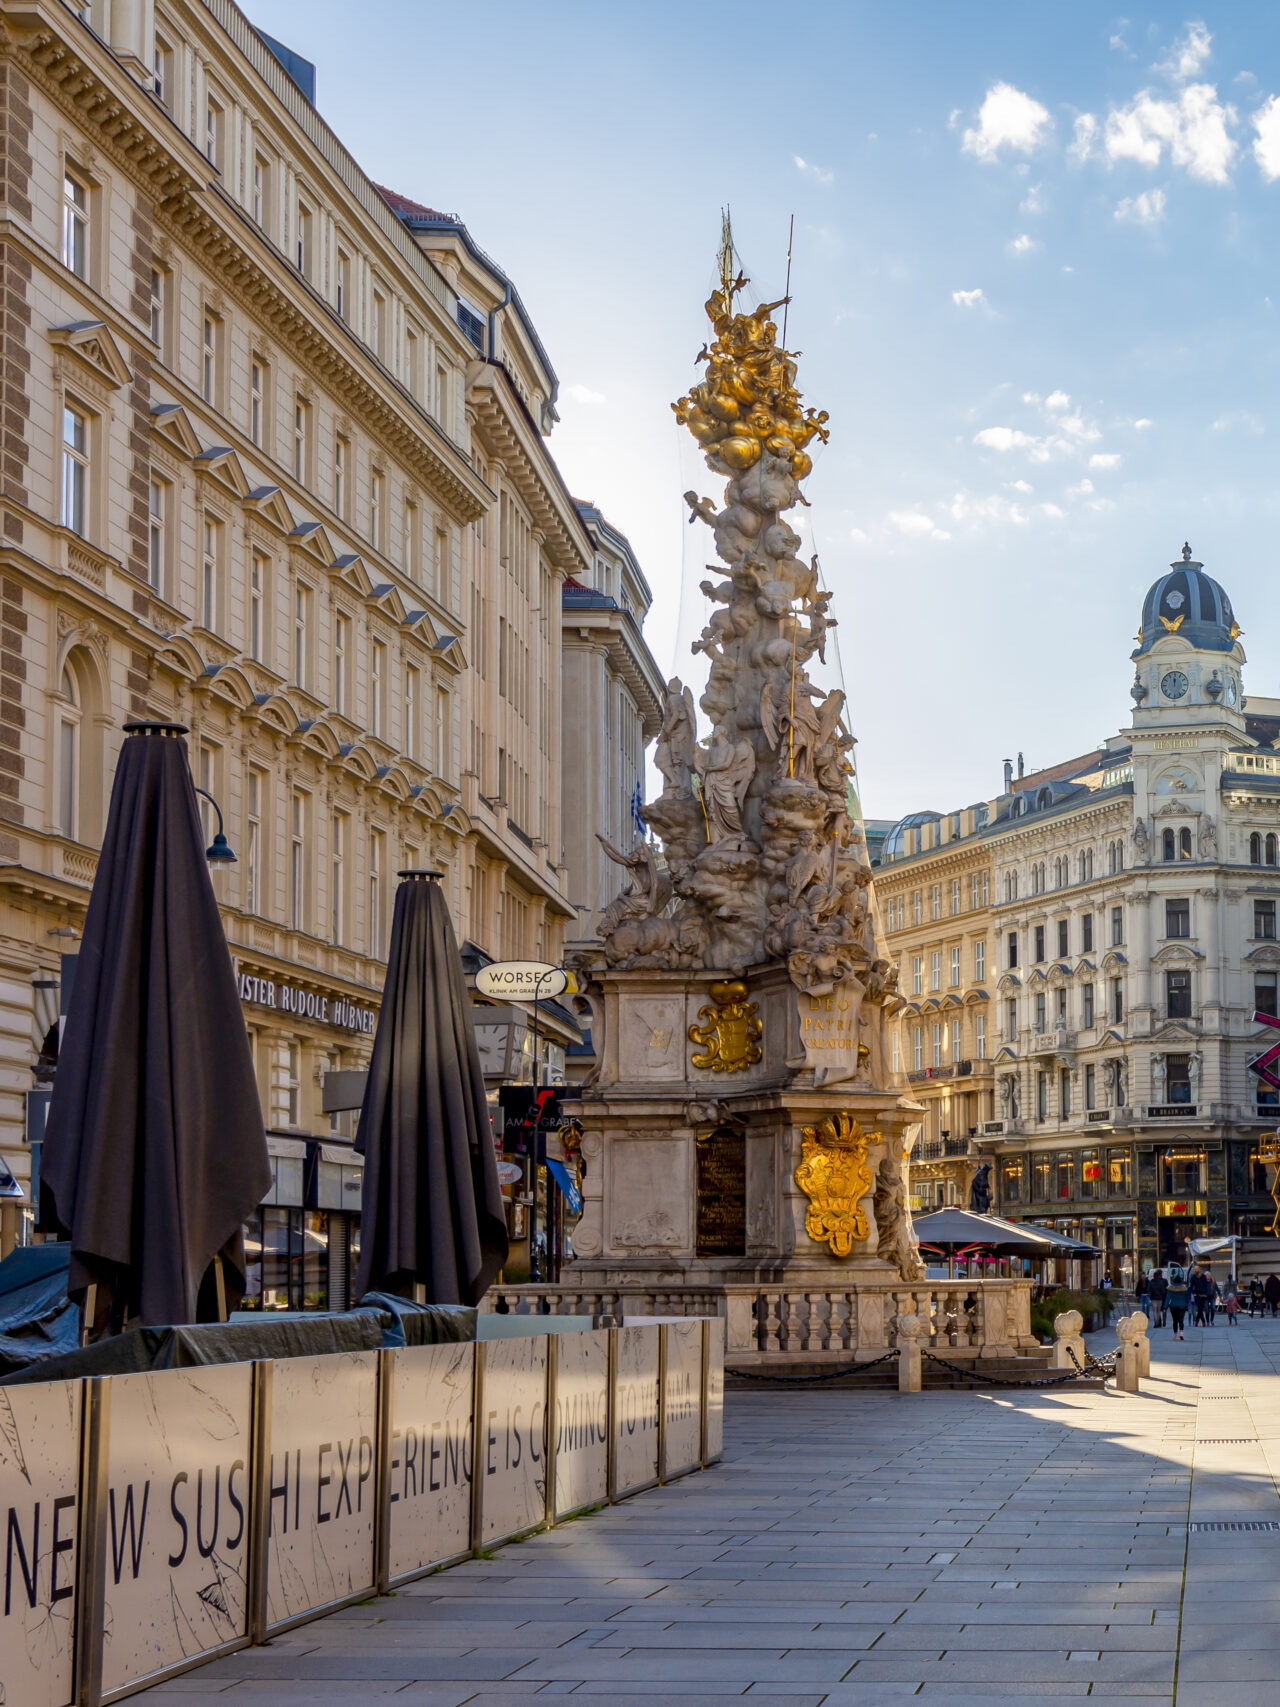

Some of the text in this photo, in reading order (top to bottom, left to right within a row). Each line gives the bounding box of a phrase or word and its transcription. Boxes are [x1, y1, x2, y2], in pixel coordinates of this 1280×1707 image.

[489, 972, 552, 984] WORSEG
[236, 972, 276, 1008] ISTER
[334, 997, 375, 1033] HÜBNER
[809, 996, 851, 1012] DEO
[805, 1016, 853, 1031] PATRI
[506, 1117, 583, 1127] AM GRABE
[5, 1480, 150, 1616] NEW
[168, 1449, 302, 1568] SUSHI
[317, 1410, 498, 1525] EXPERIENCE
[506, 1406, 522, 1470] IS
[618, 1384, 637, 1437] TO
